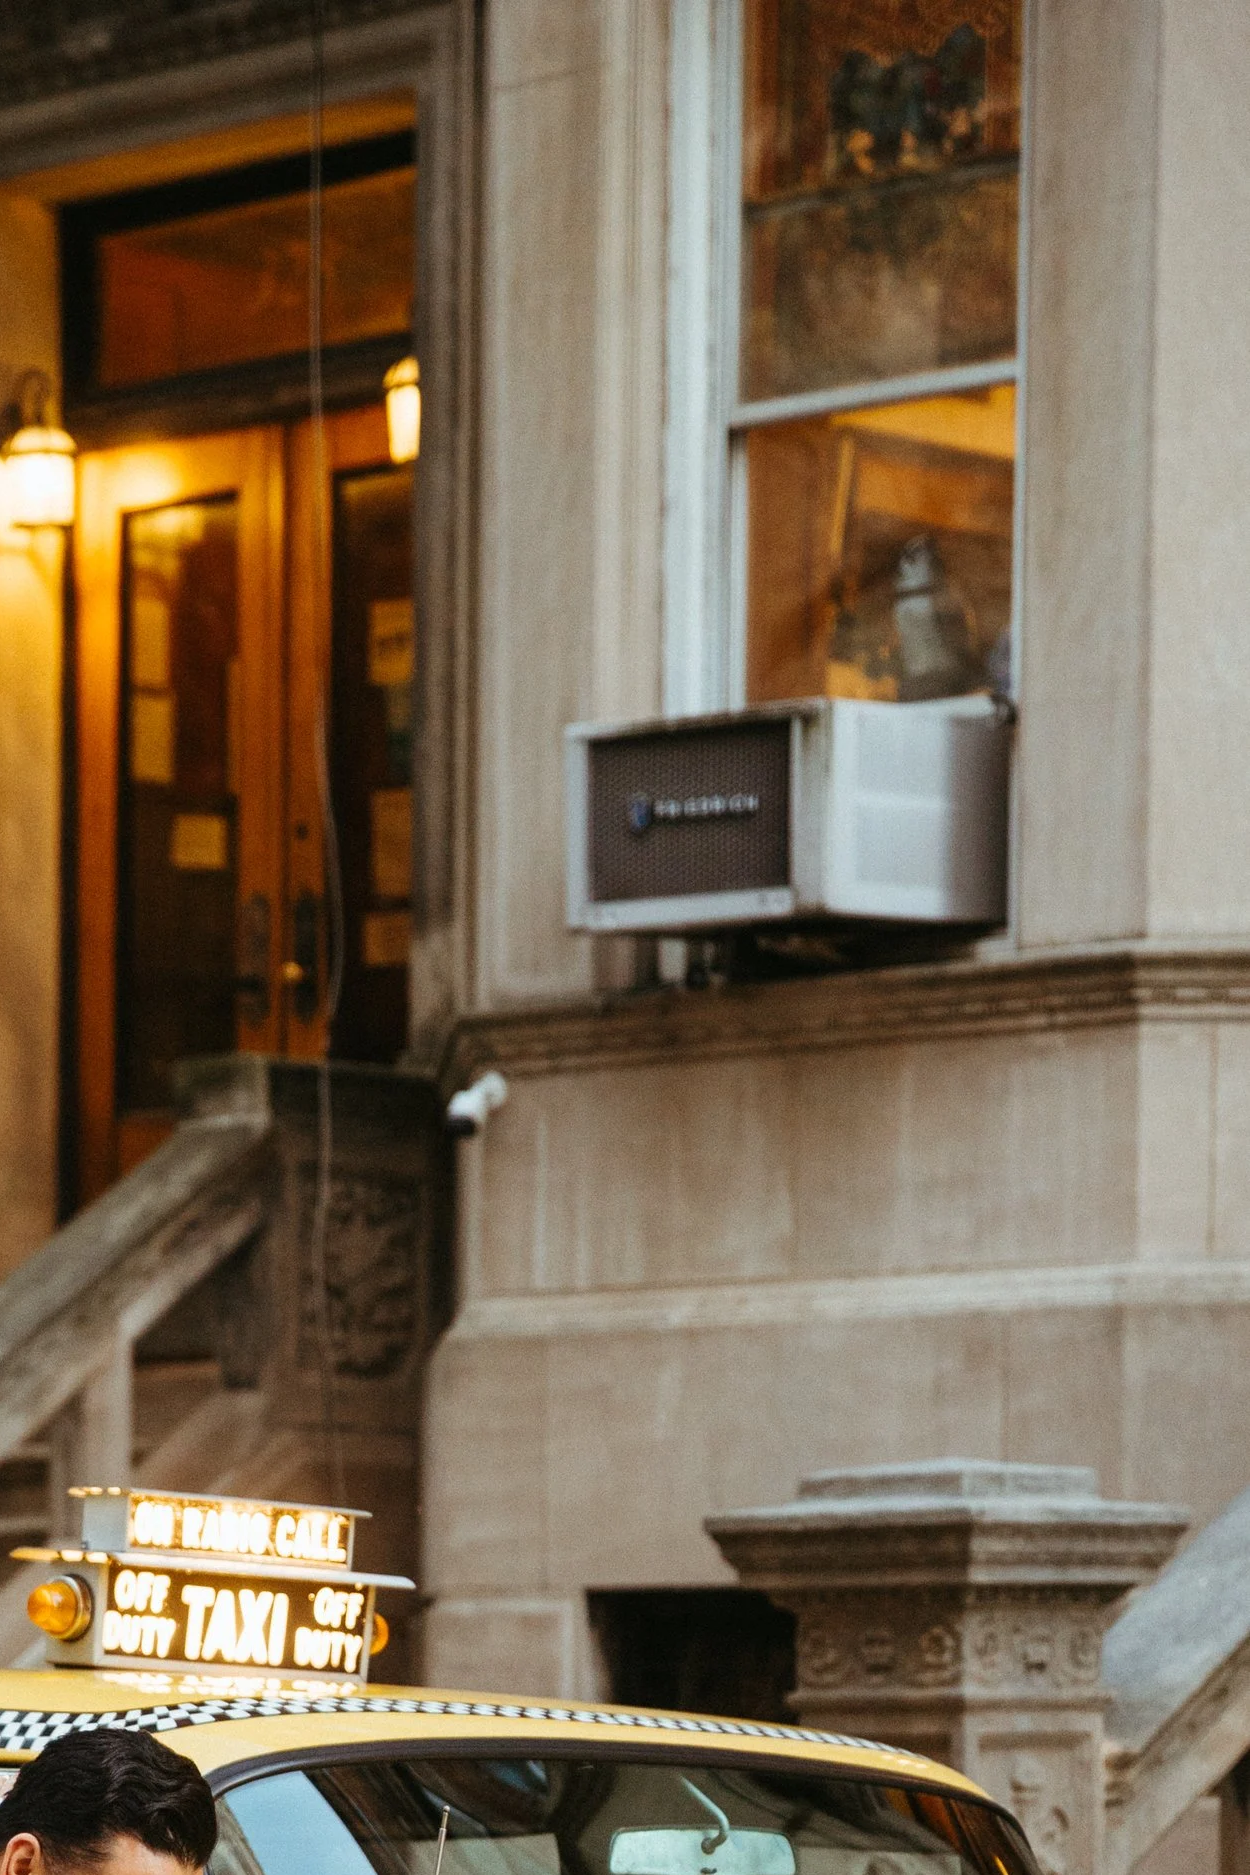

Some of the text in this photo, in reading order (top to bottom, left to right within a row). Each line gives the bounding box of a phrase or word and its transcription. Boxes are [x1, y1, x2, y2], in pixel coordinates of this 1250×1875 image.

[134, 1501, 348, 1563] ON RADIO CALL
[113, 1569, 171, 1614] OFF
[313, 1587, 365, 1630] OFF
[102, 1610, 177, 1659] DUTY
[181, 1584, 290, 1667] TAXI
[293, 1626, 364, 1673] DUTY
